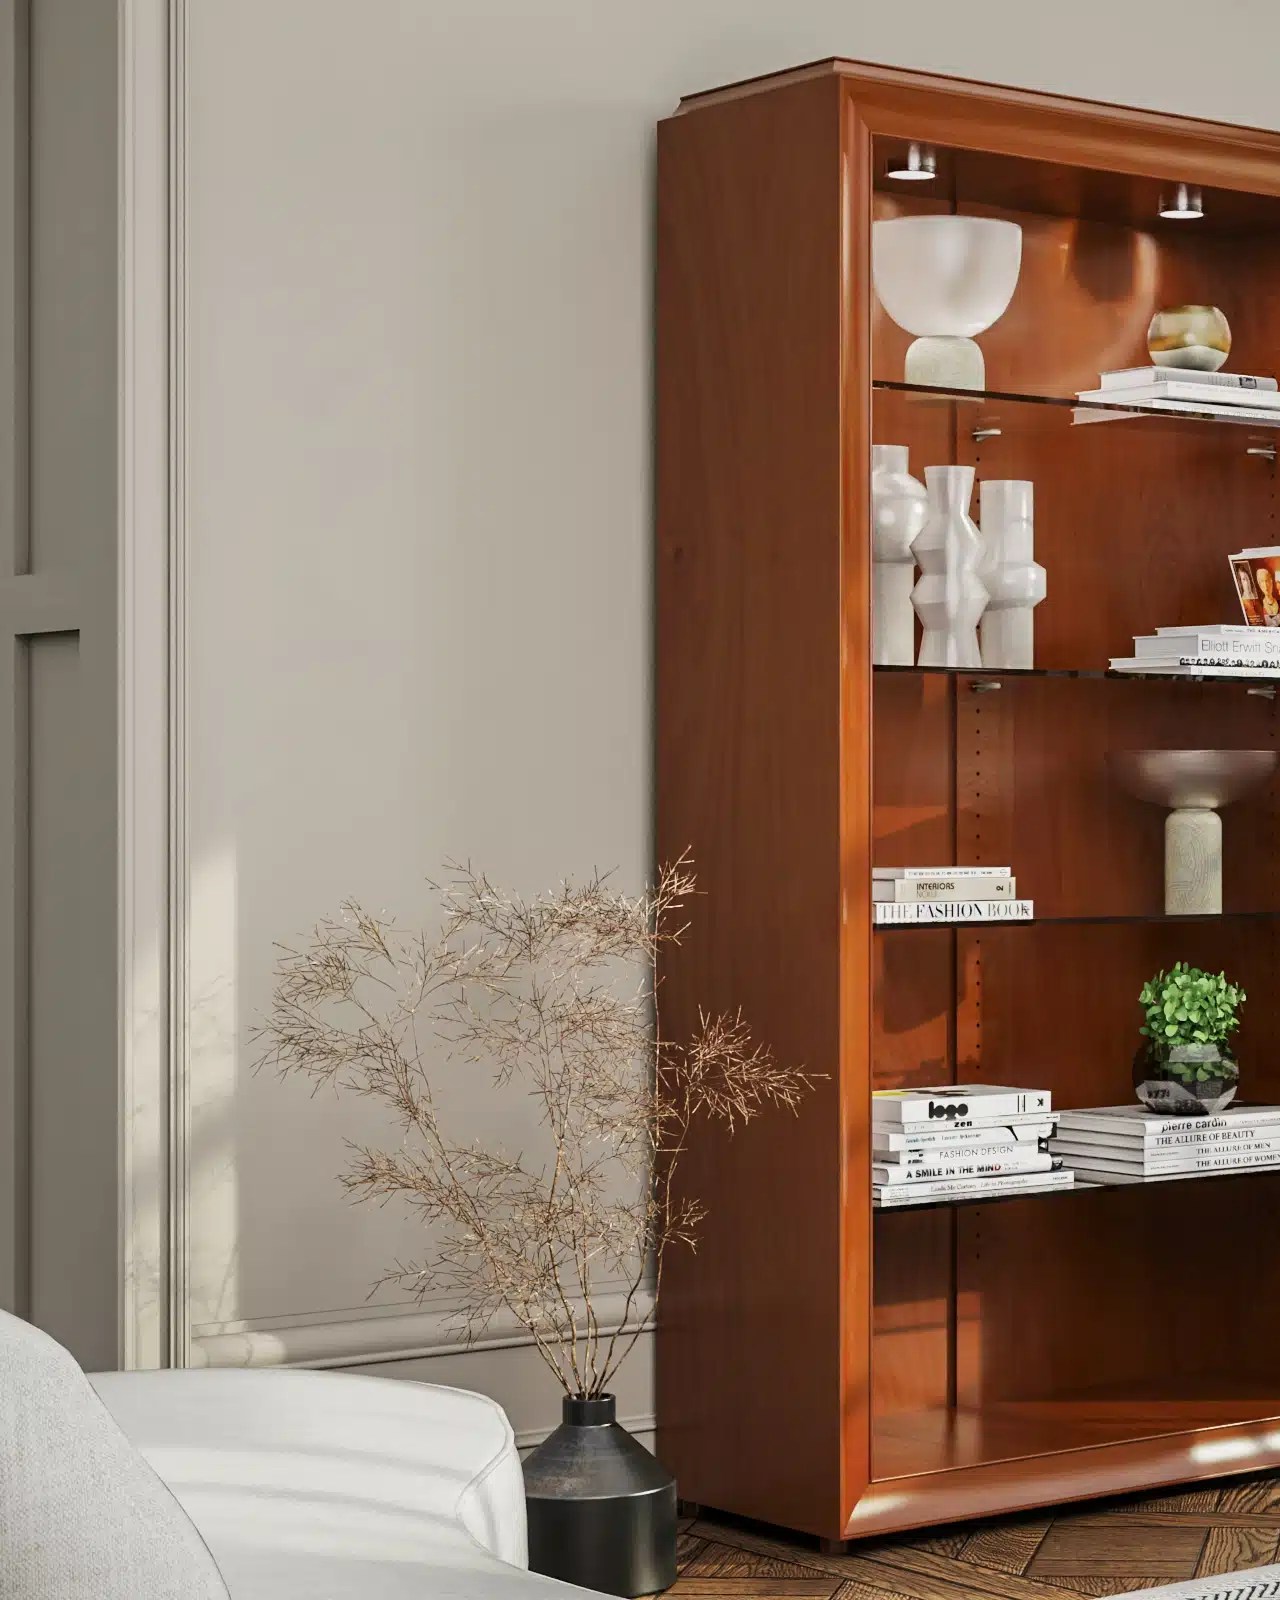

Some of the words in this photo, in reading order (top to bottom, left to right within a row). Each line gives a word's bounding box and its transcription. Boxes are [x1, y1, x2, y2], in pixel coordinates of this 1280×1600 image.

[1202, 640, 1229, 652] Elliott
[1233, 641, 1261, 652] Erwitt
[916, 882, 955, 891] INTERIORS
[879, 904, 913, 919] THE
[916, 903, 983, 919] FASHION
[987, 902, 1031, 917] BOOK
[928, 1100, 969, 1120] logo
[1161, 1121, 1192, 1134] pierre
[1195, 1117, 1227, 1129] cardin
[1155, 1136, 1173, 1145] THE
[1174, 1134, 1208, 1144] ALLURE
[1208, 1132, 1220, 1141] OF
[1221, 1130, 1255, 1140] BEAUTY
[939, 1149, 978, 1160] FASHION
[981, 1146, 1014, 1157] DESIGN
[1196, 1147, 1212, 1155] THE
[1213, 1145, 1242, 1154] ALLURE
[1243, 1143, 1252, 1151] OF
[1254, 1142, 1271, 1150] MEN
[1196, 1160, 1212, 1168] THE
[1213, 1157, 1242, 1167] ALLURE
[1243, 1156, 1252, 1164] OF
[906, 1170, 913, 1179] A
[915, 1169, 943, 1178] SMILE
[945, 1167, 955, 1175] IN
[958, 1166, 974, 1174] THE
[976, 1164, 1001, 1172] MIND
